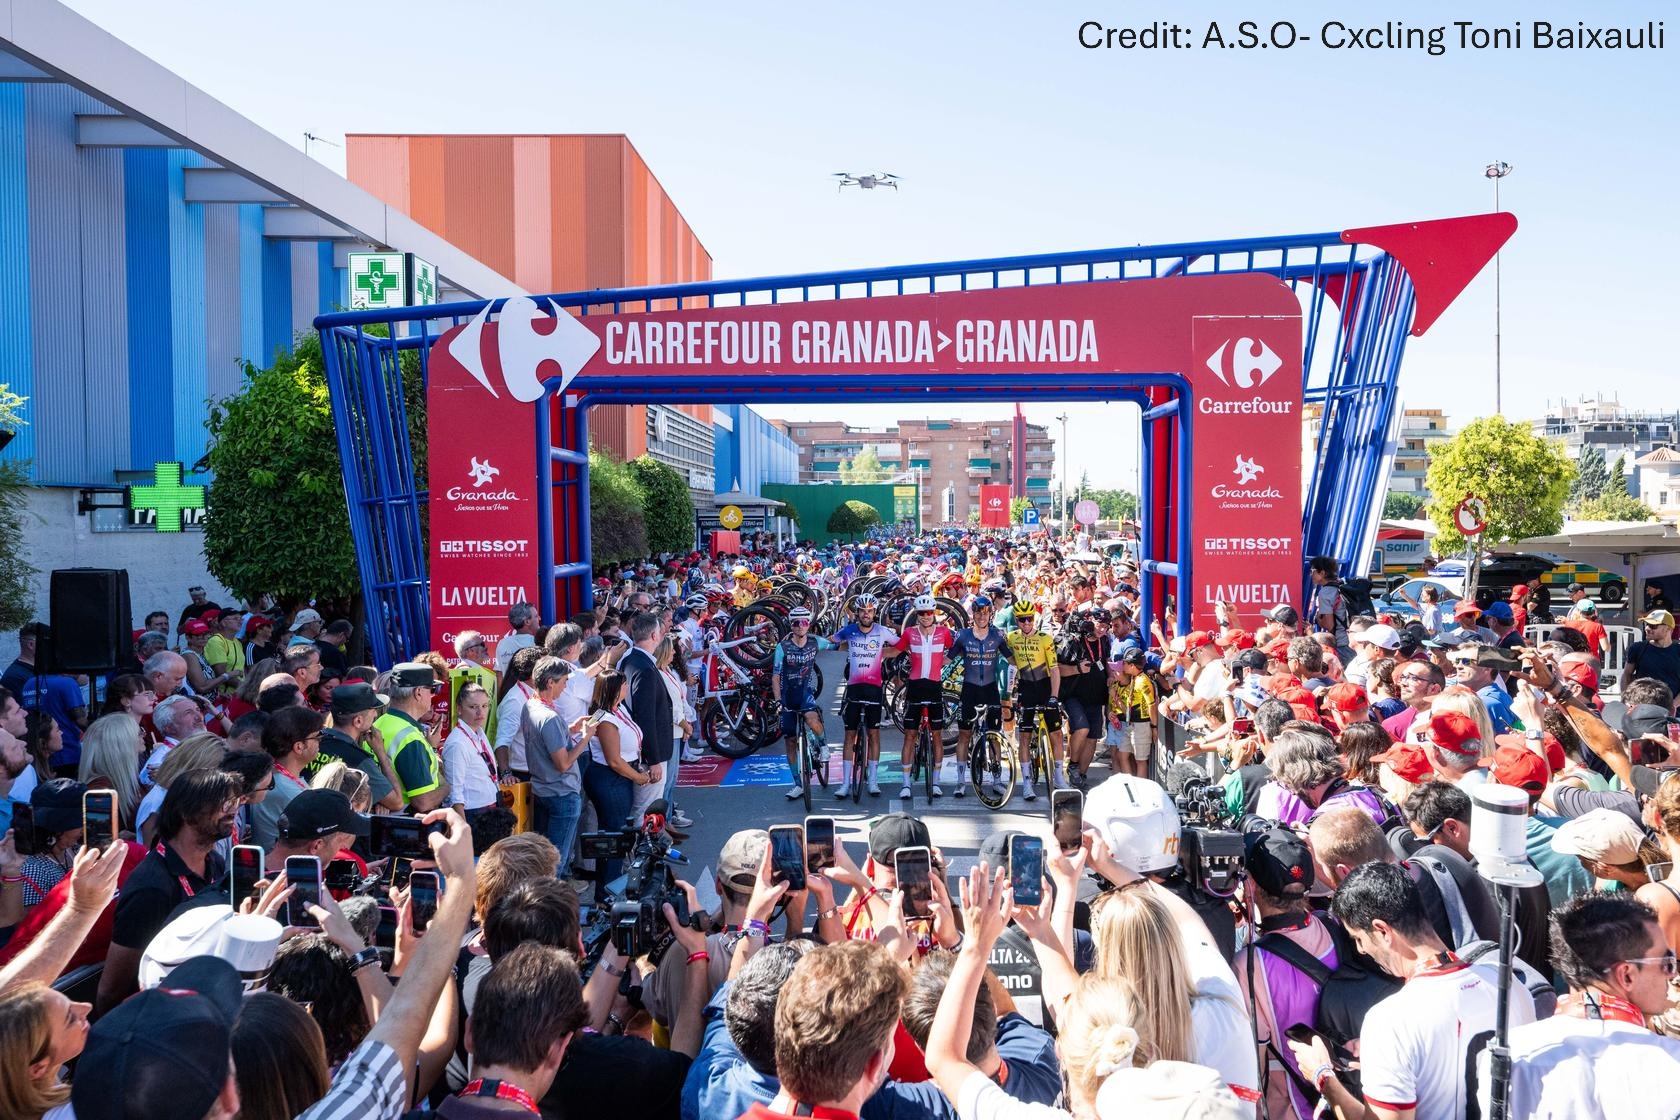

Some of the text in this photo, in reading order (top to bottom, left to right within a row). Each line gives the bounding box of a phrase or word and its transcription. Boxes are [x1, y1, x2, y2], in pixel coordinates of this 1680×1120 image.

[606, 321, 781, 364] CARREFOUR
[1199, 397, 1292, 414] Carrefour
[446, 487, 520, 501] Granada
[1211, 484, 1284, 499] Granada
[1027, 511, 1036, 524] P
[465, 540, 529, 552] TISSOT
[1229, 538, 1292, 550] TISSOT
[1386, 543, 1420, 552] sanir
[441, 586, 527, 606] LA VUELTA
[1205, 584, 1291, 604] LA VUELTA
